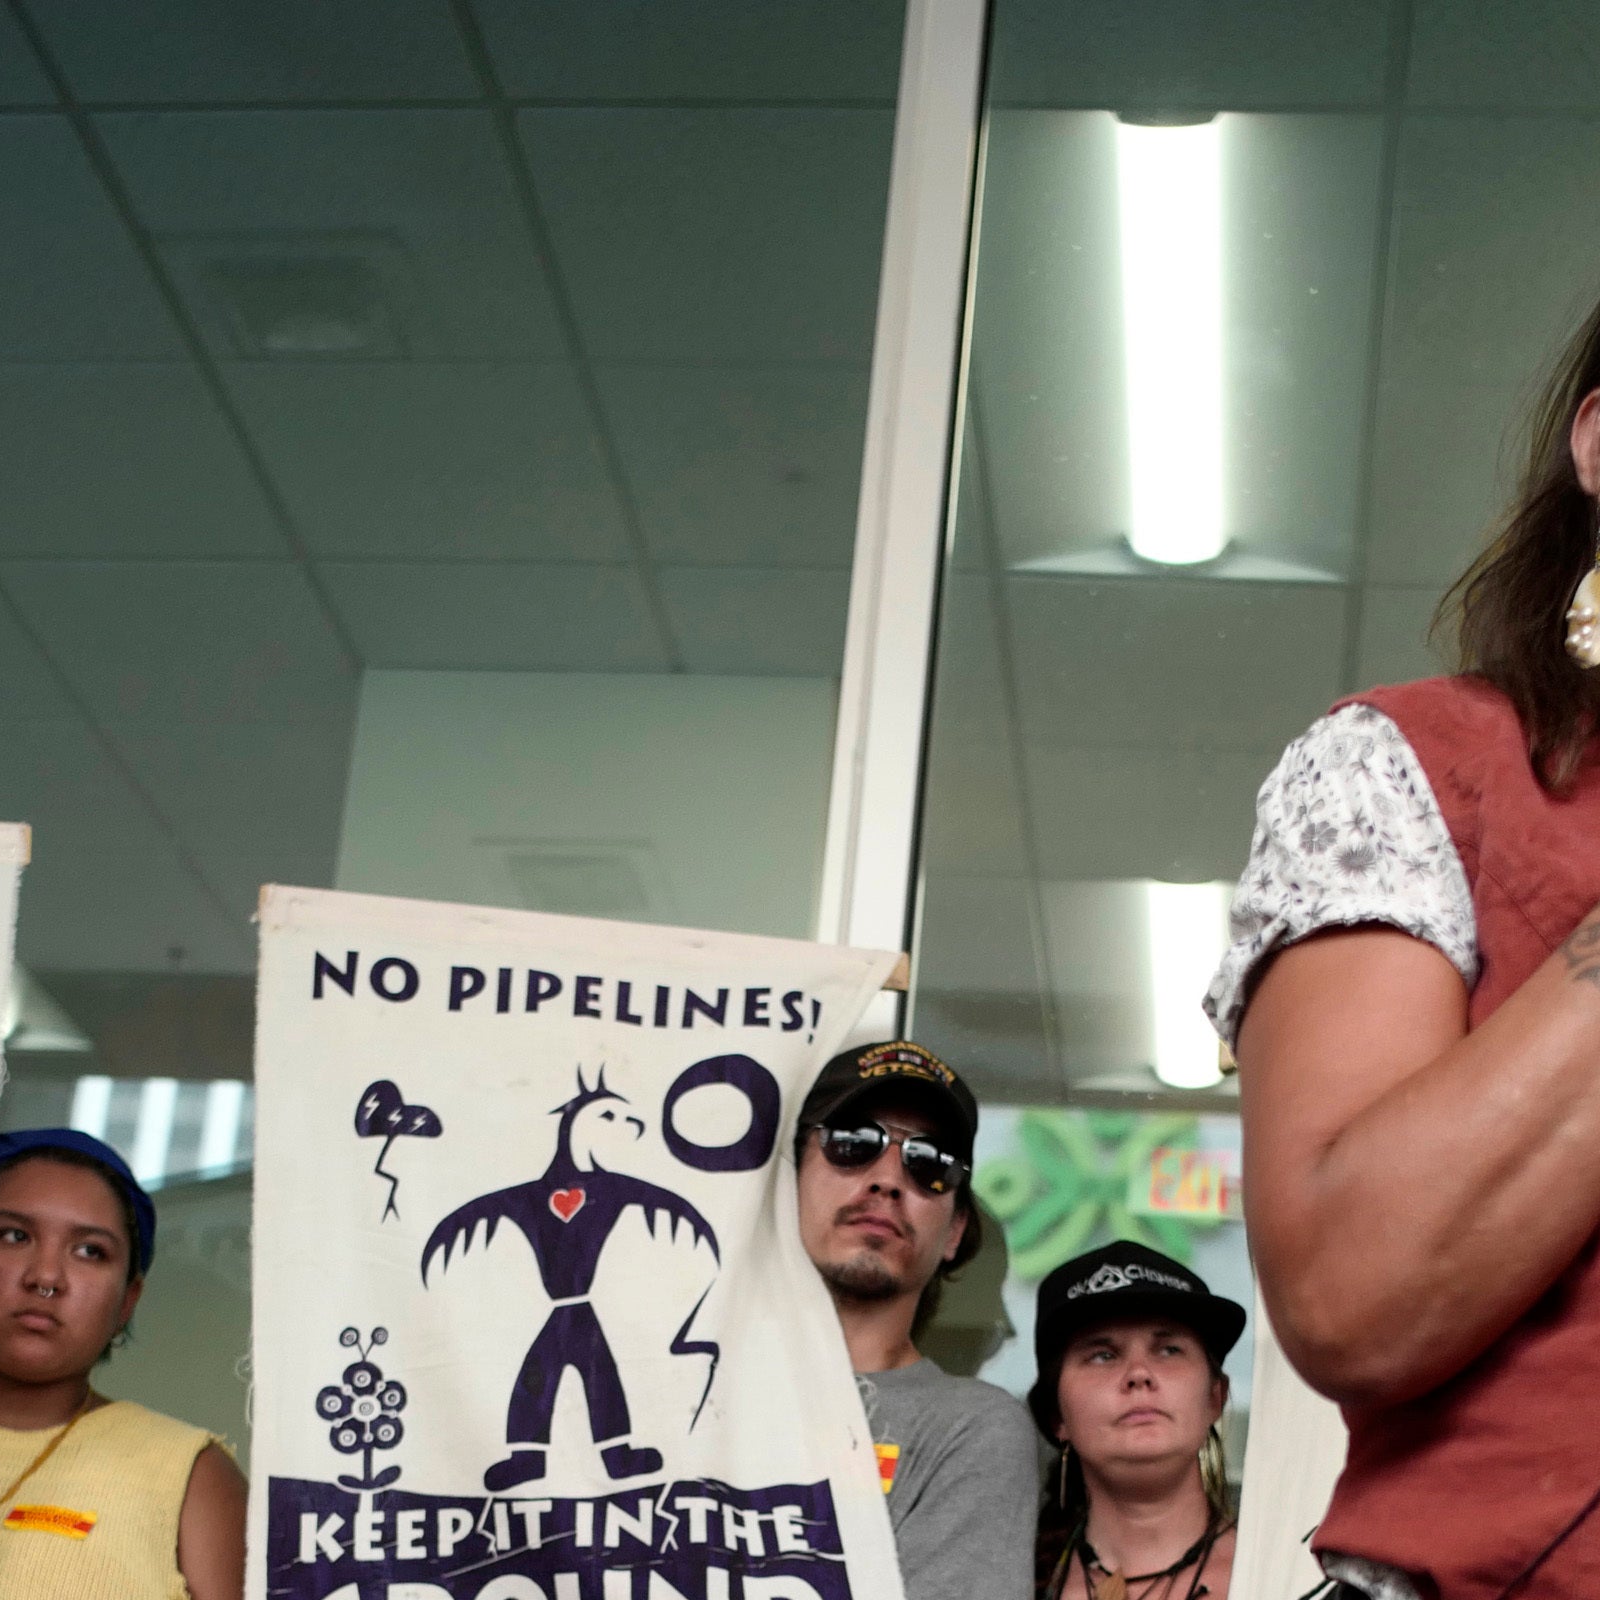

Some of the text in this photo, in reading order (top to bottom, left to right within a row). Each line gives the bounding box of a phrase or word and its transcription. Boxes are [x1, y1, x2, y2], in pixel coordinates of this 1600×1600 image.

[312, 949, 823, 1045] NO PIPELINES!
[299, 1496, 809, 1564] KEEP IT IN THE
